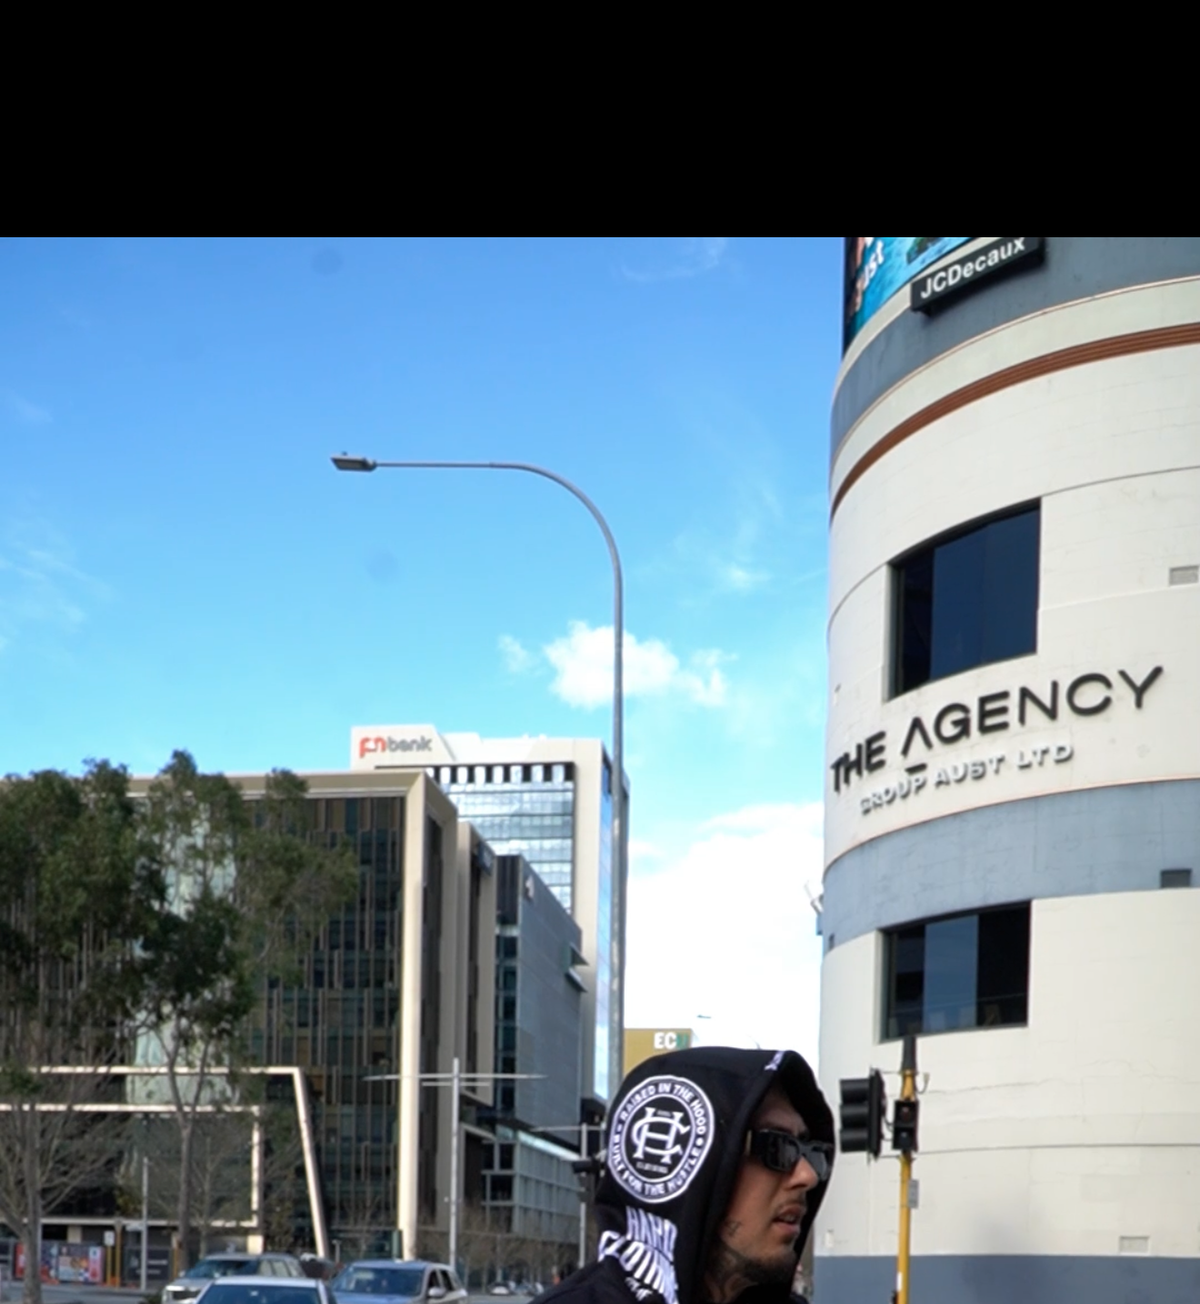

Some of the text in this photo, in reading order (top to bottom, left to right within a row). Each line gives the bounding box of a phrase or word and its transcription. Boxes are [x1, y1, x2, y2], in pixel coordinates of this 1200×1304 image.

[920, 236, 1026, 299] JCDecaux
[830, 665, 1164, 793] THE AGENCY
[860, 742, 1075, 815] GROUP AUST LTD
[620, 1082, 707, 1135] RAISED IN THE HOOD
[644, 1182, 666, 1196] THE
[667, 1148, 701, 1193] HUSTLE
[625, 1205, 678, 1263] HARD
